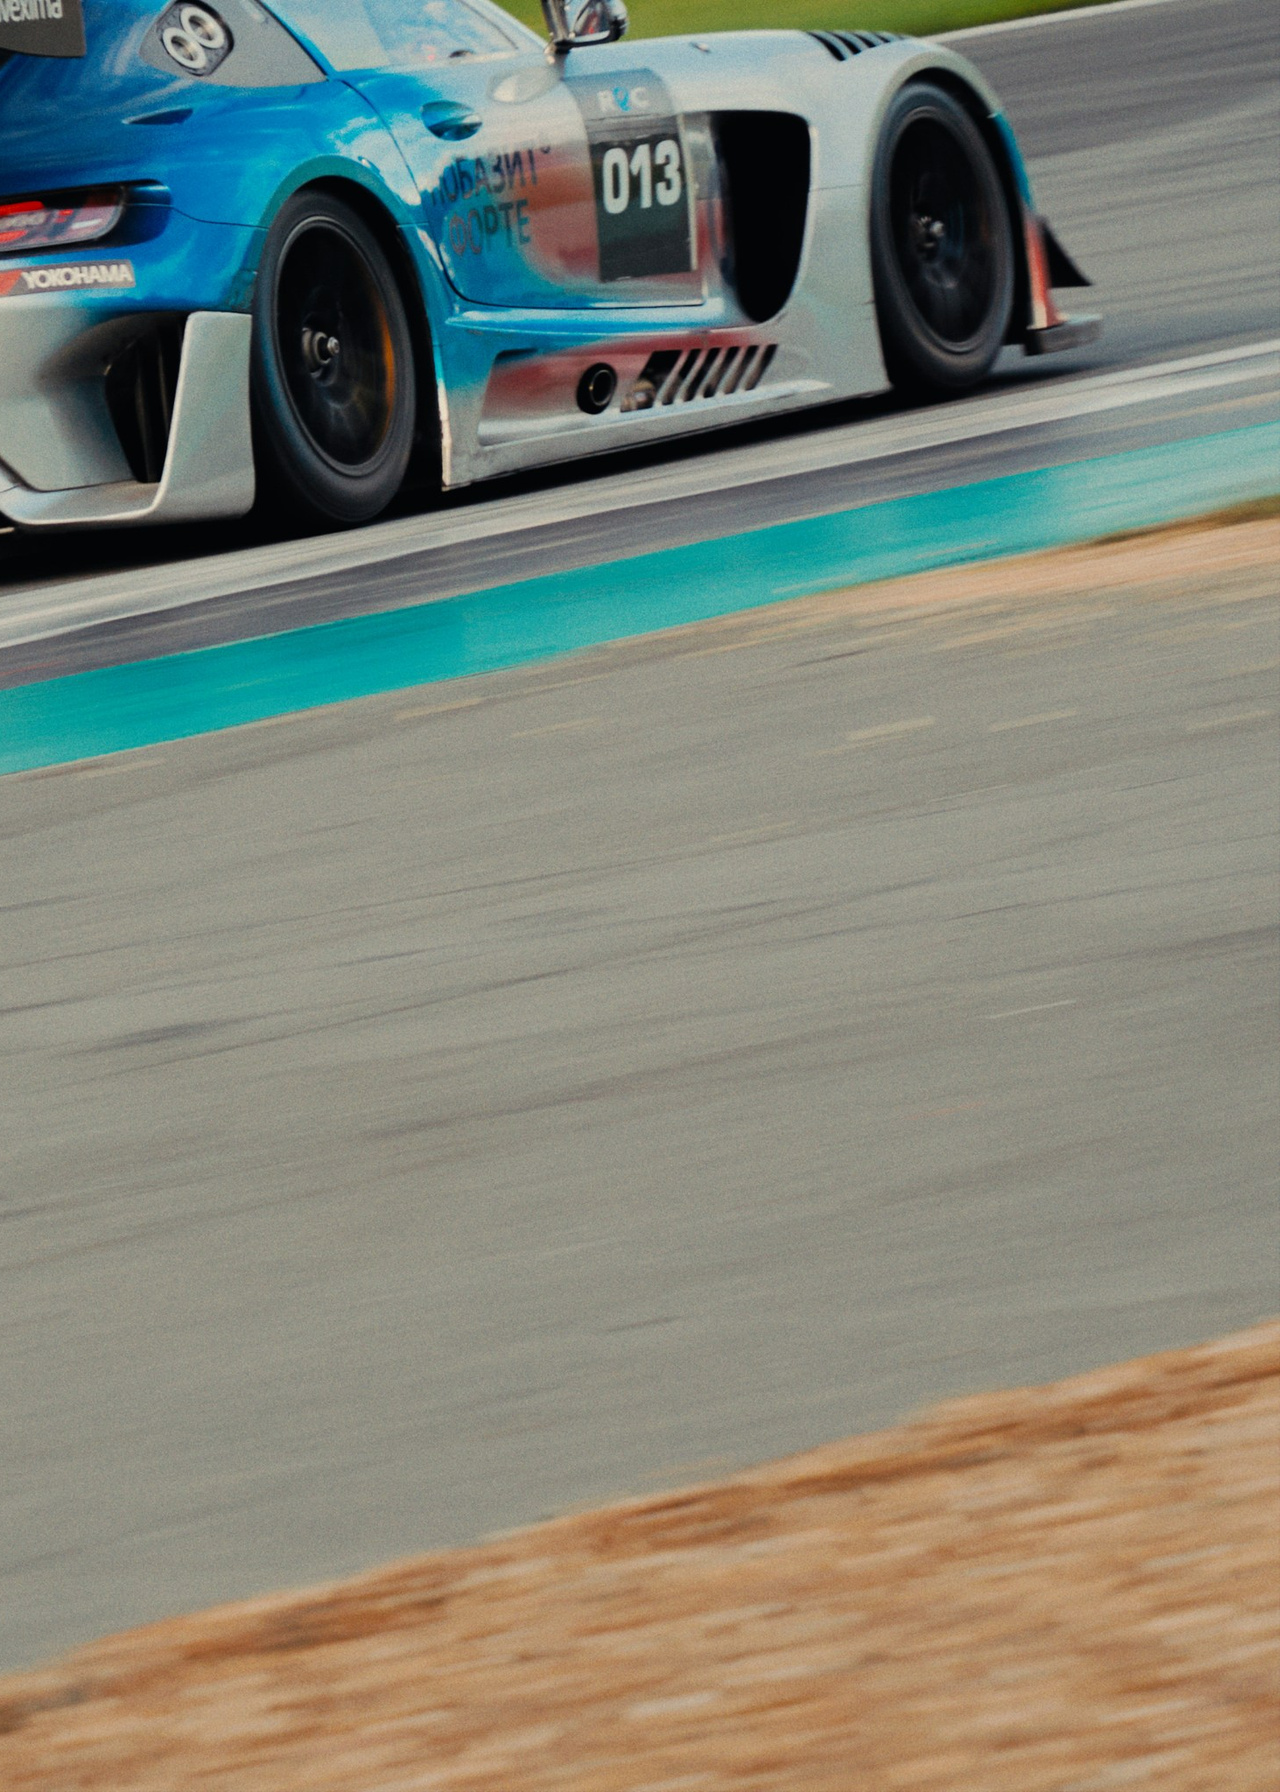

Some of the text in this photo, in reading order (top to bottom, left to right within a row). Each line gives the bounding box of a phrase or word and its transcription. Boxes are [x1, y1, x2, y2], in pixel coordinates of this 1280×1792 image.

[602, 139, 681, 215] 013
[449, 199, 531, 256] ФОРТЕ
[21, 263, 133, 289] YOKOHAMA
